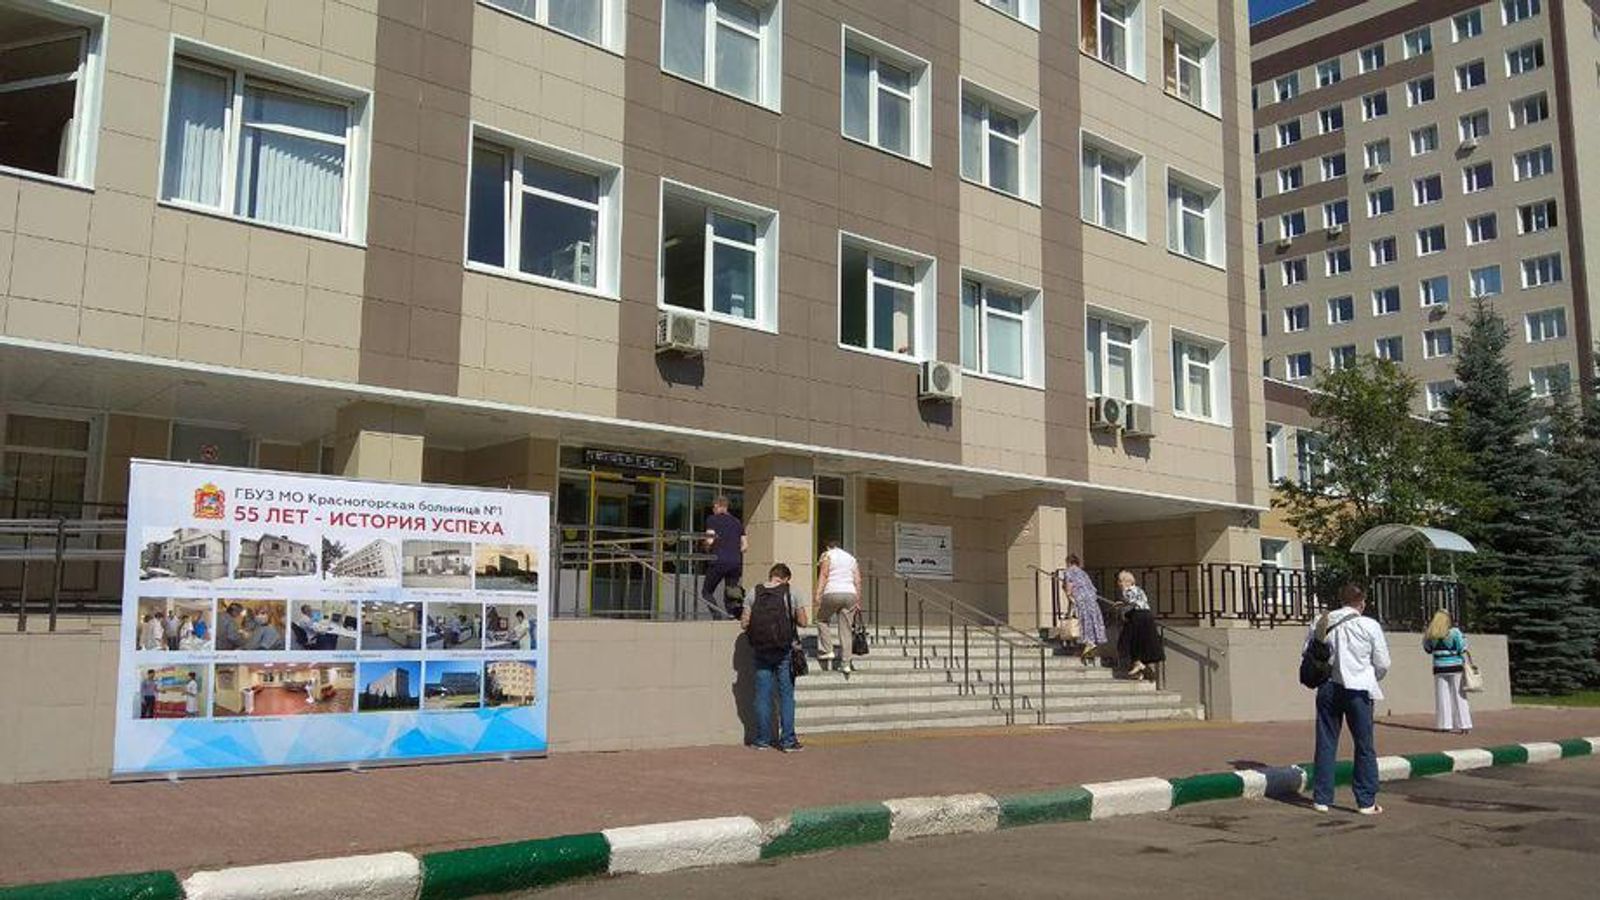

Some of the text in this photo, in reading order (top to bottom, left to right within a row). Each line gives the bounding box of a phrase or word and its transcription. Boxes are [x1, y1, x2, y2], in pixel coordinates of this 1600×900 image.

[234, 488, 503, 517] ГБУЗ МО Красногорская больница №1
[234, 506, 259, 522] 55
[265, 508, 309, 524] ЛЕТ
[329, 512, 425, 530] ИСТОРИЯ
[432, 518, 504, 535] УСПЕХА
